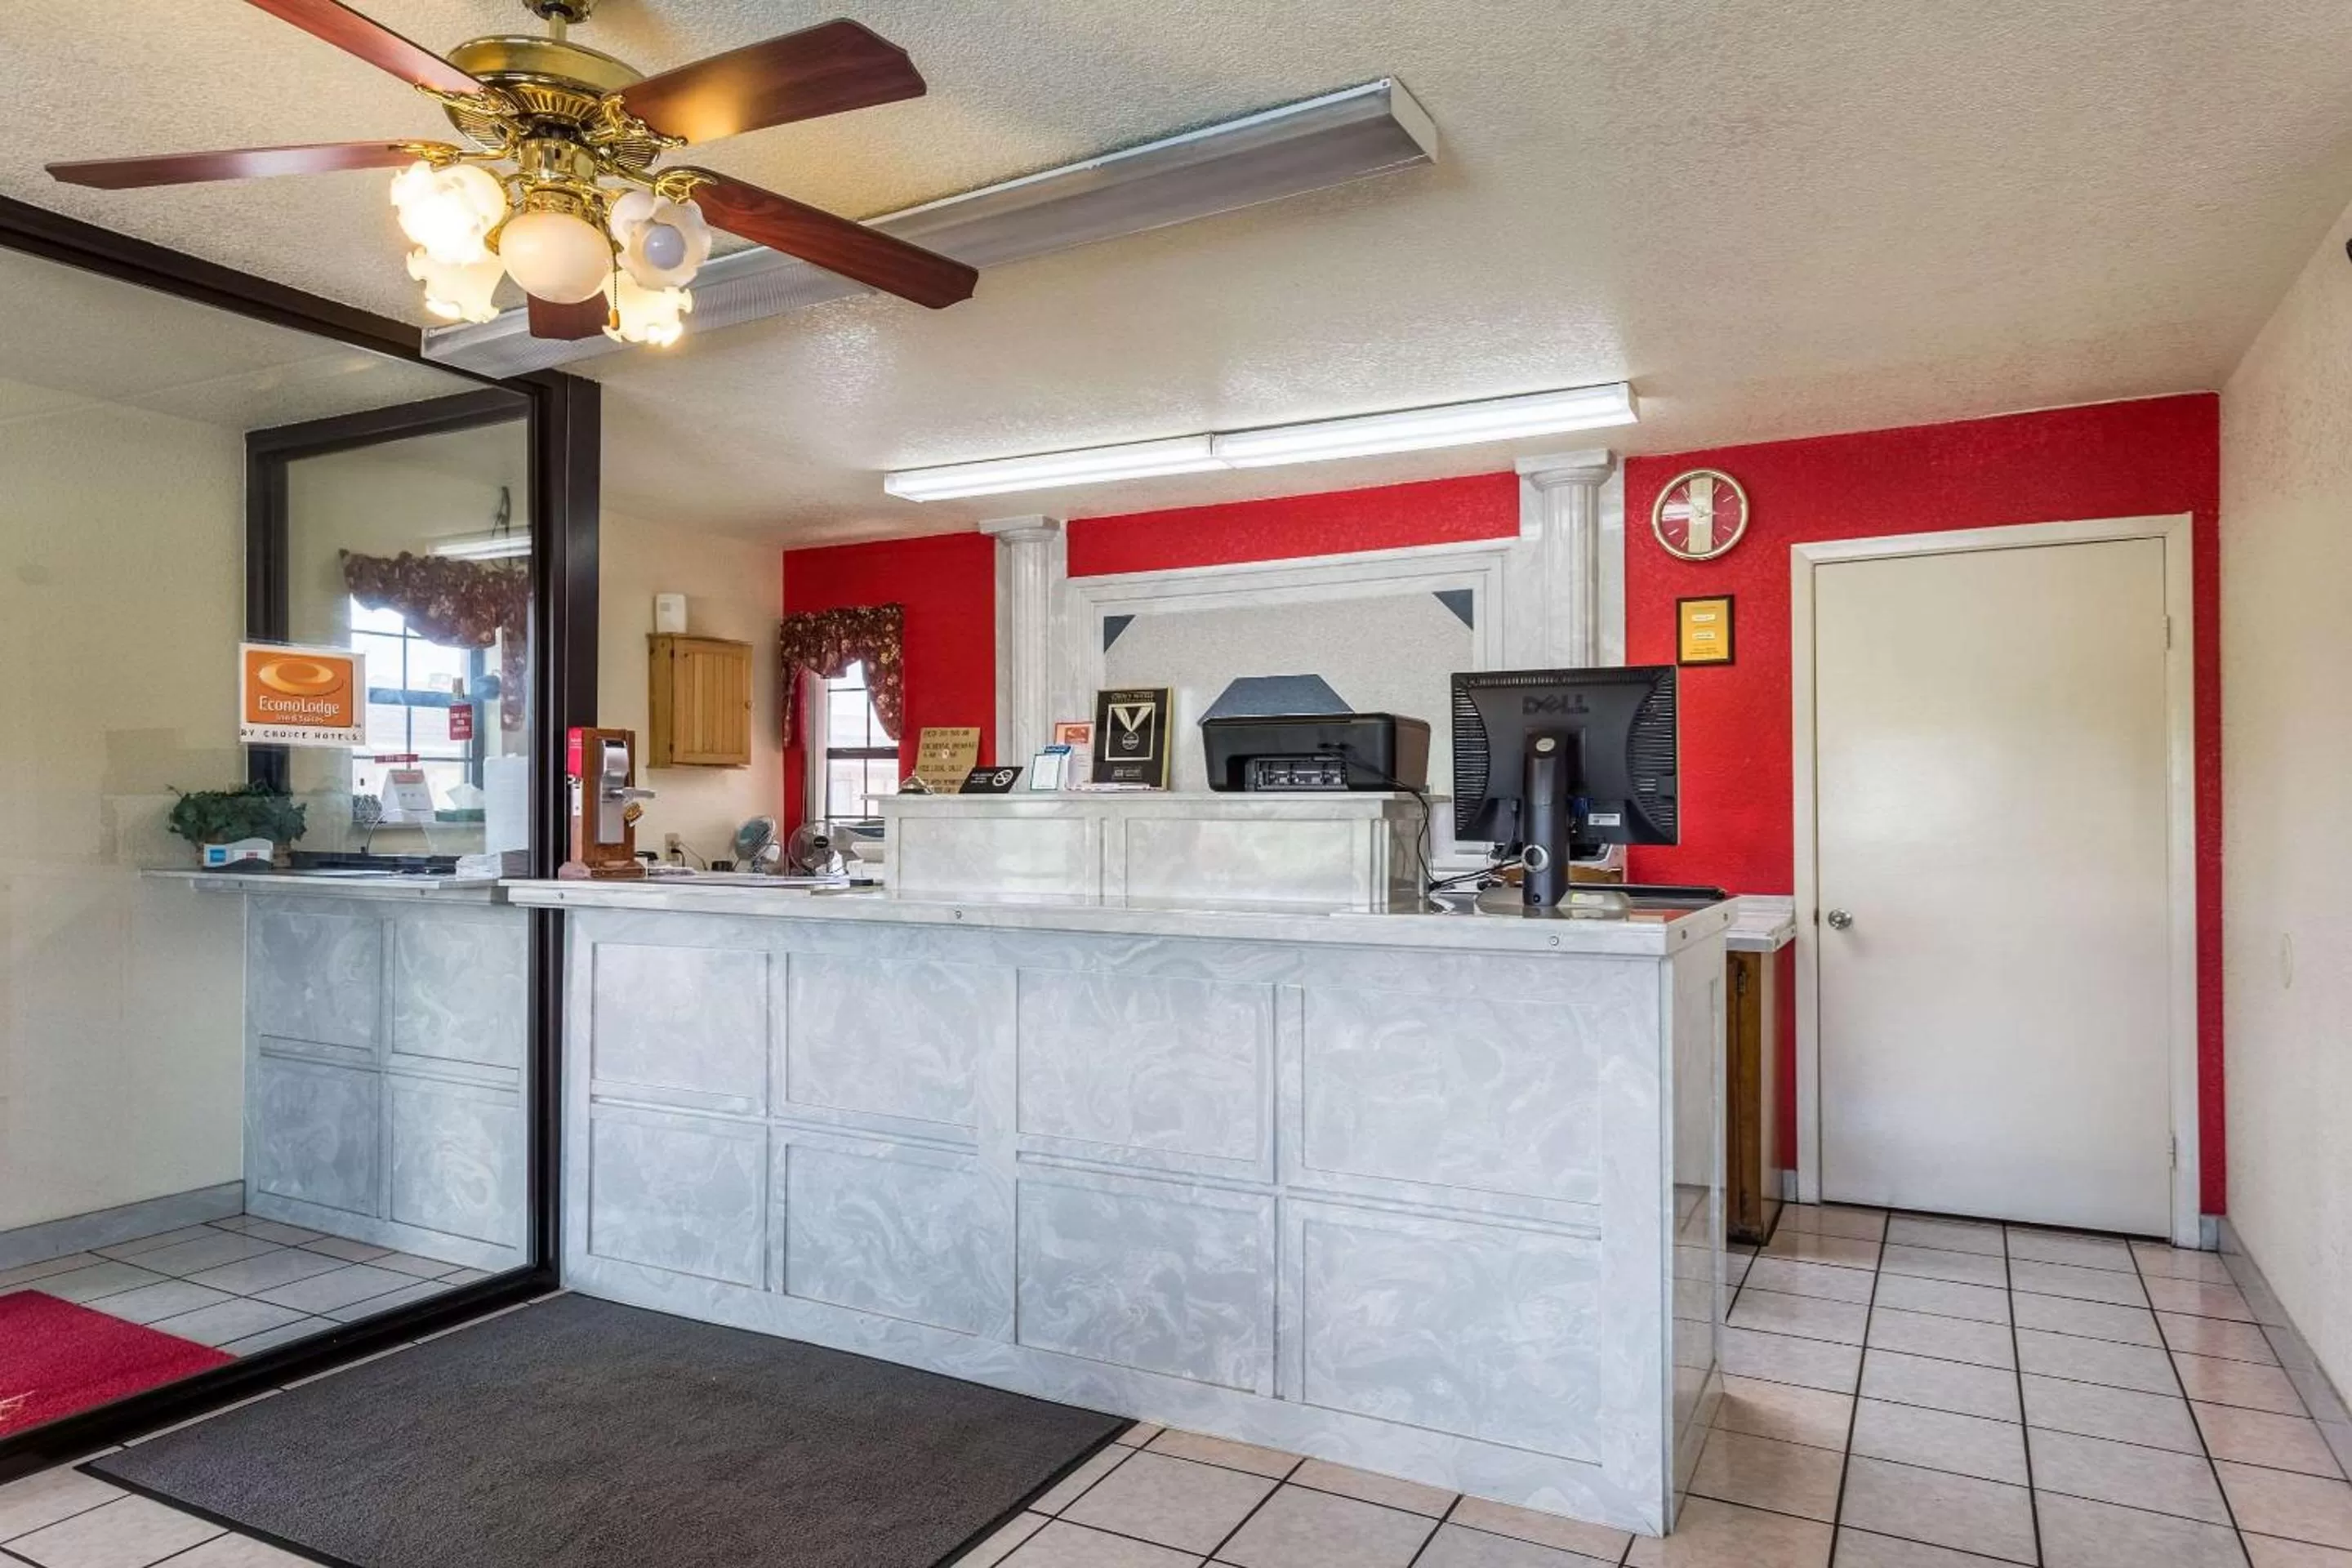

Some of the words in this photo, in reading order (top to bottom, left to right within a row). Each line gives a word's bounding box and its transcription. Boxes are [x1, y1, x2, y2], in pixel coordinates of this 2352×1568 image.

[1521, 693, 1589, 715] DELL
[263, 730, 307, 739] CHOICE
[314, 732, 359, 742] HOTELS
